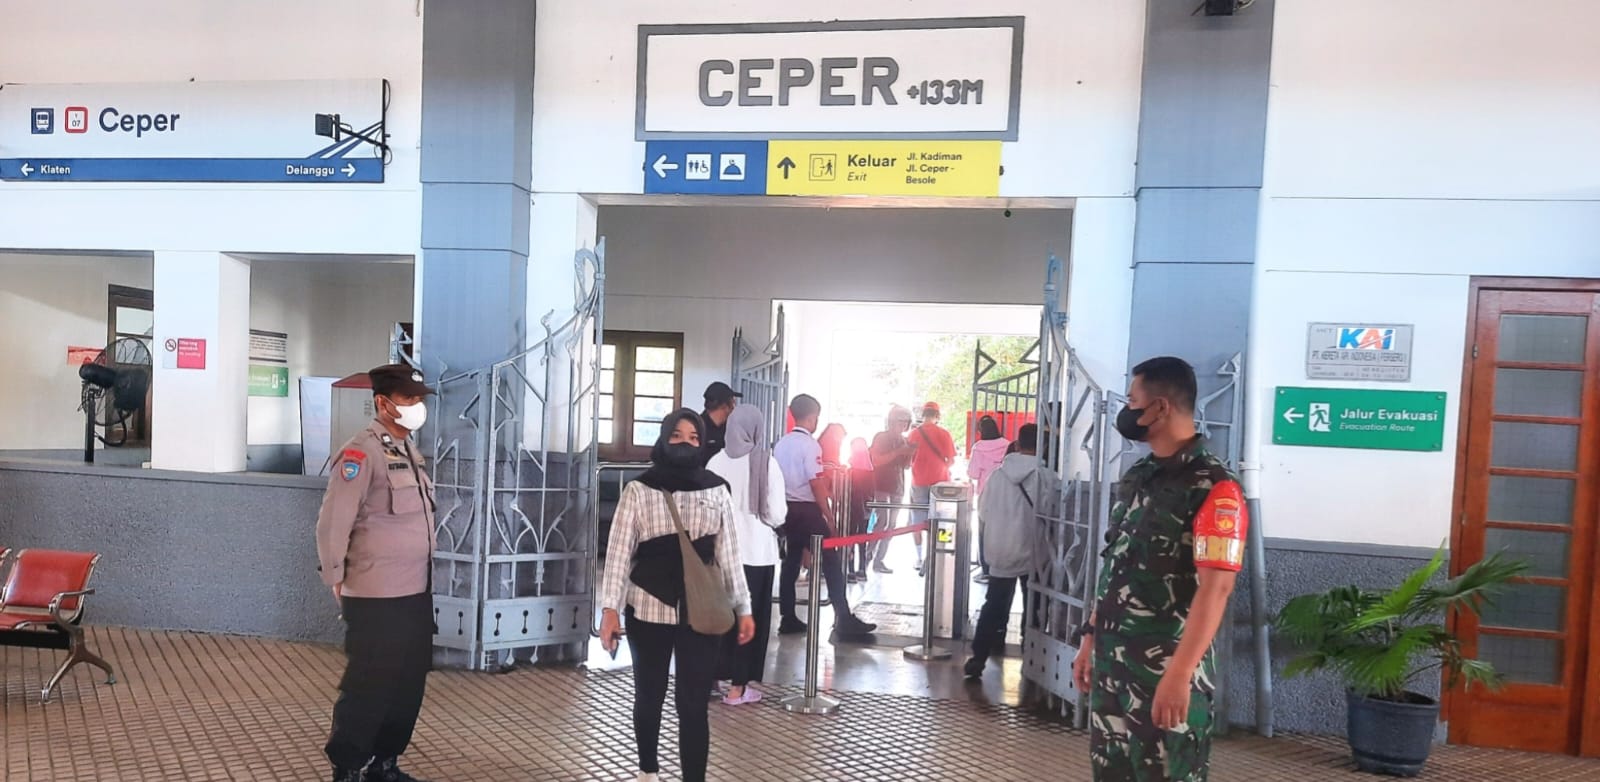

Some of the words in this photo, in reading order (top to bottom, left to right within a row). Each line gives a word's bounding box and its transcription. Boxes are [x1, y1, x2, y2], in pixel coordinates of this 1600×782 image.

[698, 56, 900, 107] CEPER
[907, 79, 984, 105] +133M
[71, 119, 81, 128] 07
[99, 107, 180, 138] Ceper
[847, 154, 897, 167] Keluar
[906, 152, 918, 161] Jl.
[920, 152, 962, 161] Kadiman
[40, 165, 71, 175] Klaten
[286, 165, 335, 177] Delanggu
[905, 164, 917, 173] Jl.
[919, 164, 949, 175] Ceper
[847, 172, 867, 182] Exit
[905, 175, 936, 184] Besole
[1340, 408, 1375, 419] Jalur
[1378, 409, 1438, 421] Evakuasi
[1339, 422, 1388, 432] Evacuation
[1389, 423, 1415, 432] Route
